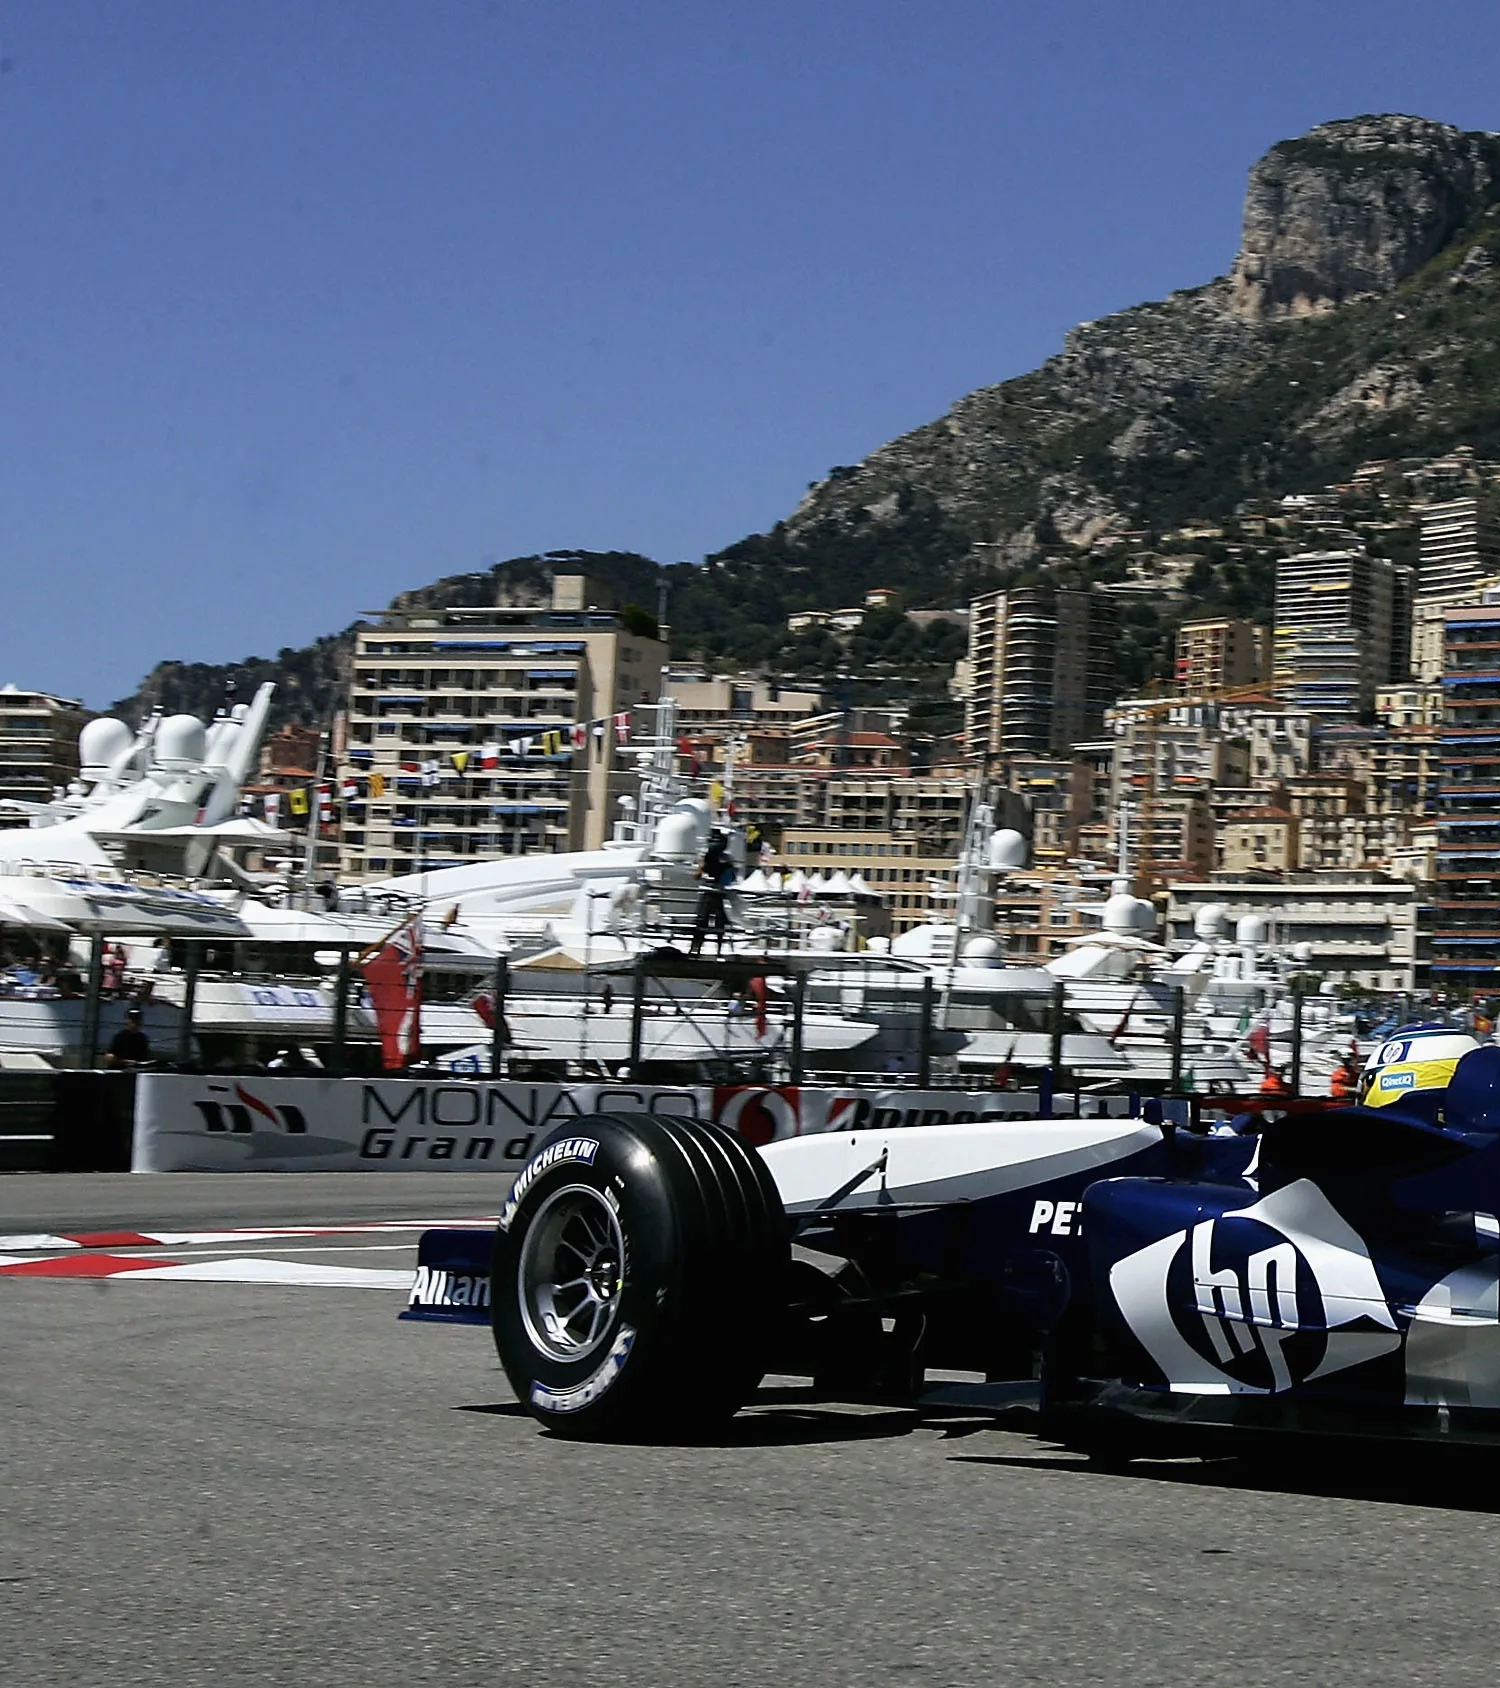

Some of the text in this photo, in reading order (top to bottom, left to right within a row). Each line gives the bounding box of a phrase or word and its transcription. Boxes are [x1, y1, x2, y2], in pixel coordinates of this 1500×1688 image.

[360, 1128, 535, 1160] Grand
[512, 1138, 598, 1201] MICHELIN
[1029, 1200, 1082, 1236] PE
[1193, 1219, 1298, 1392] hp
